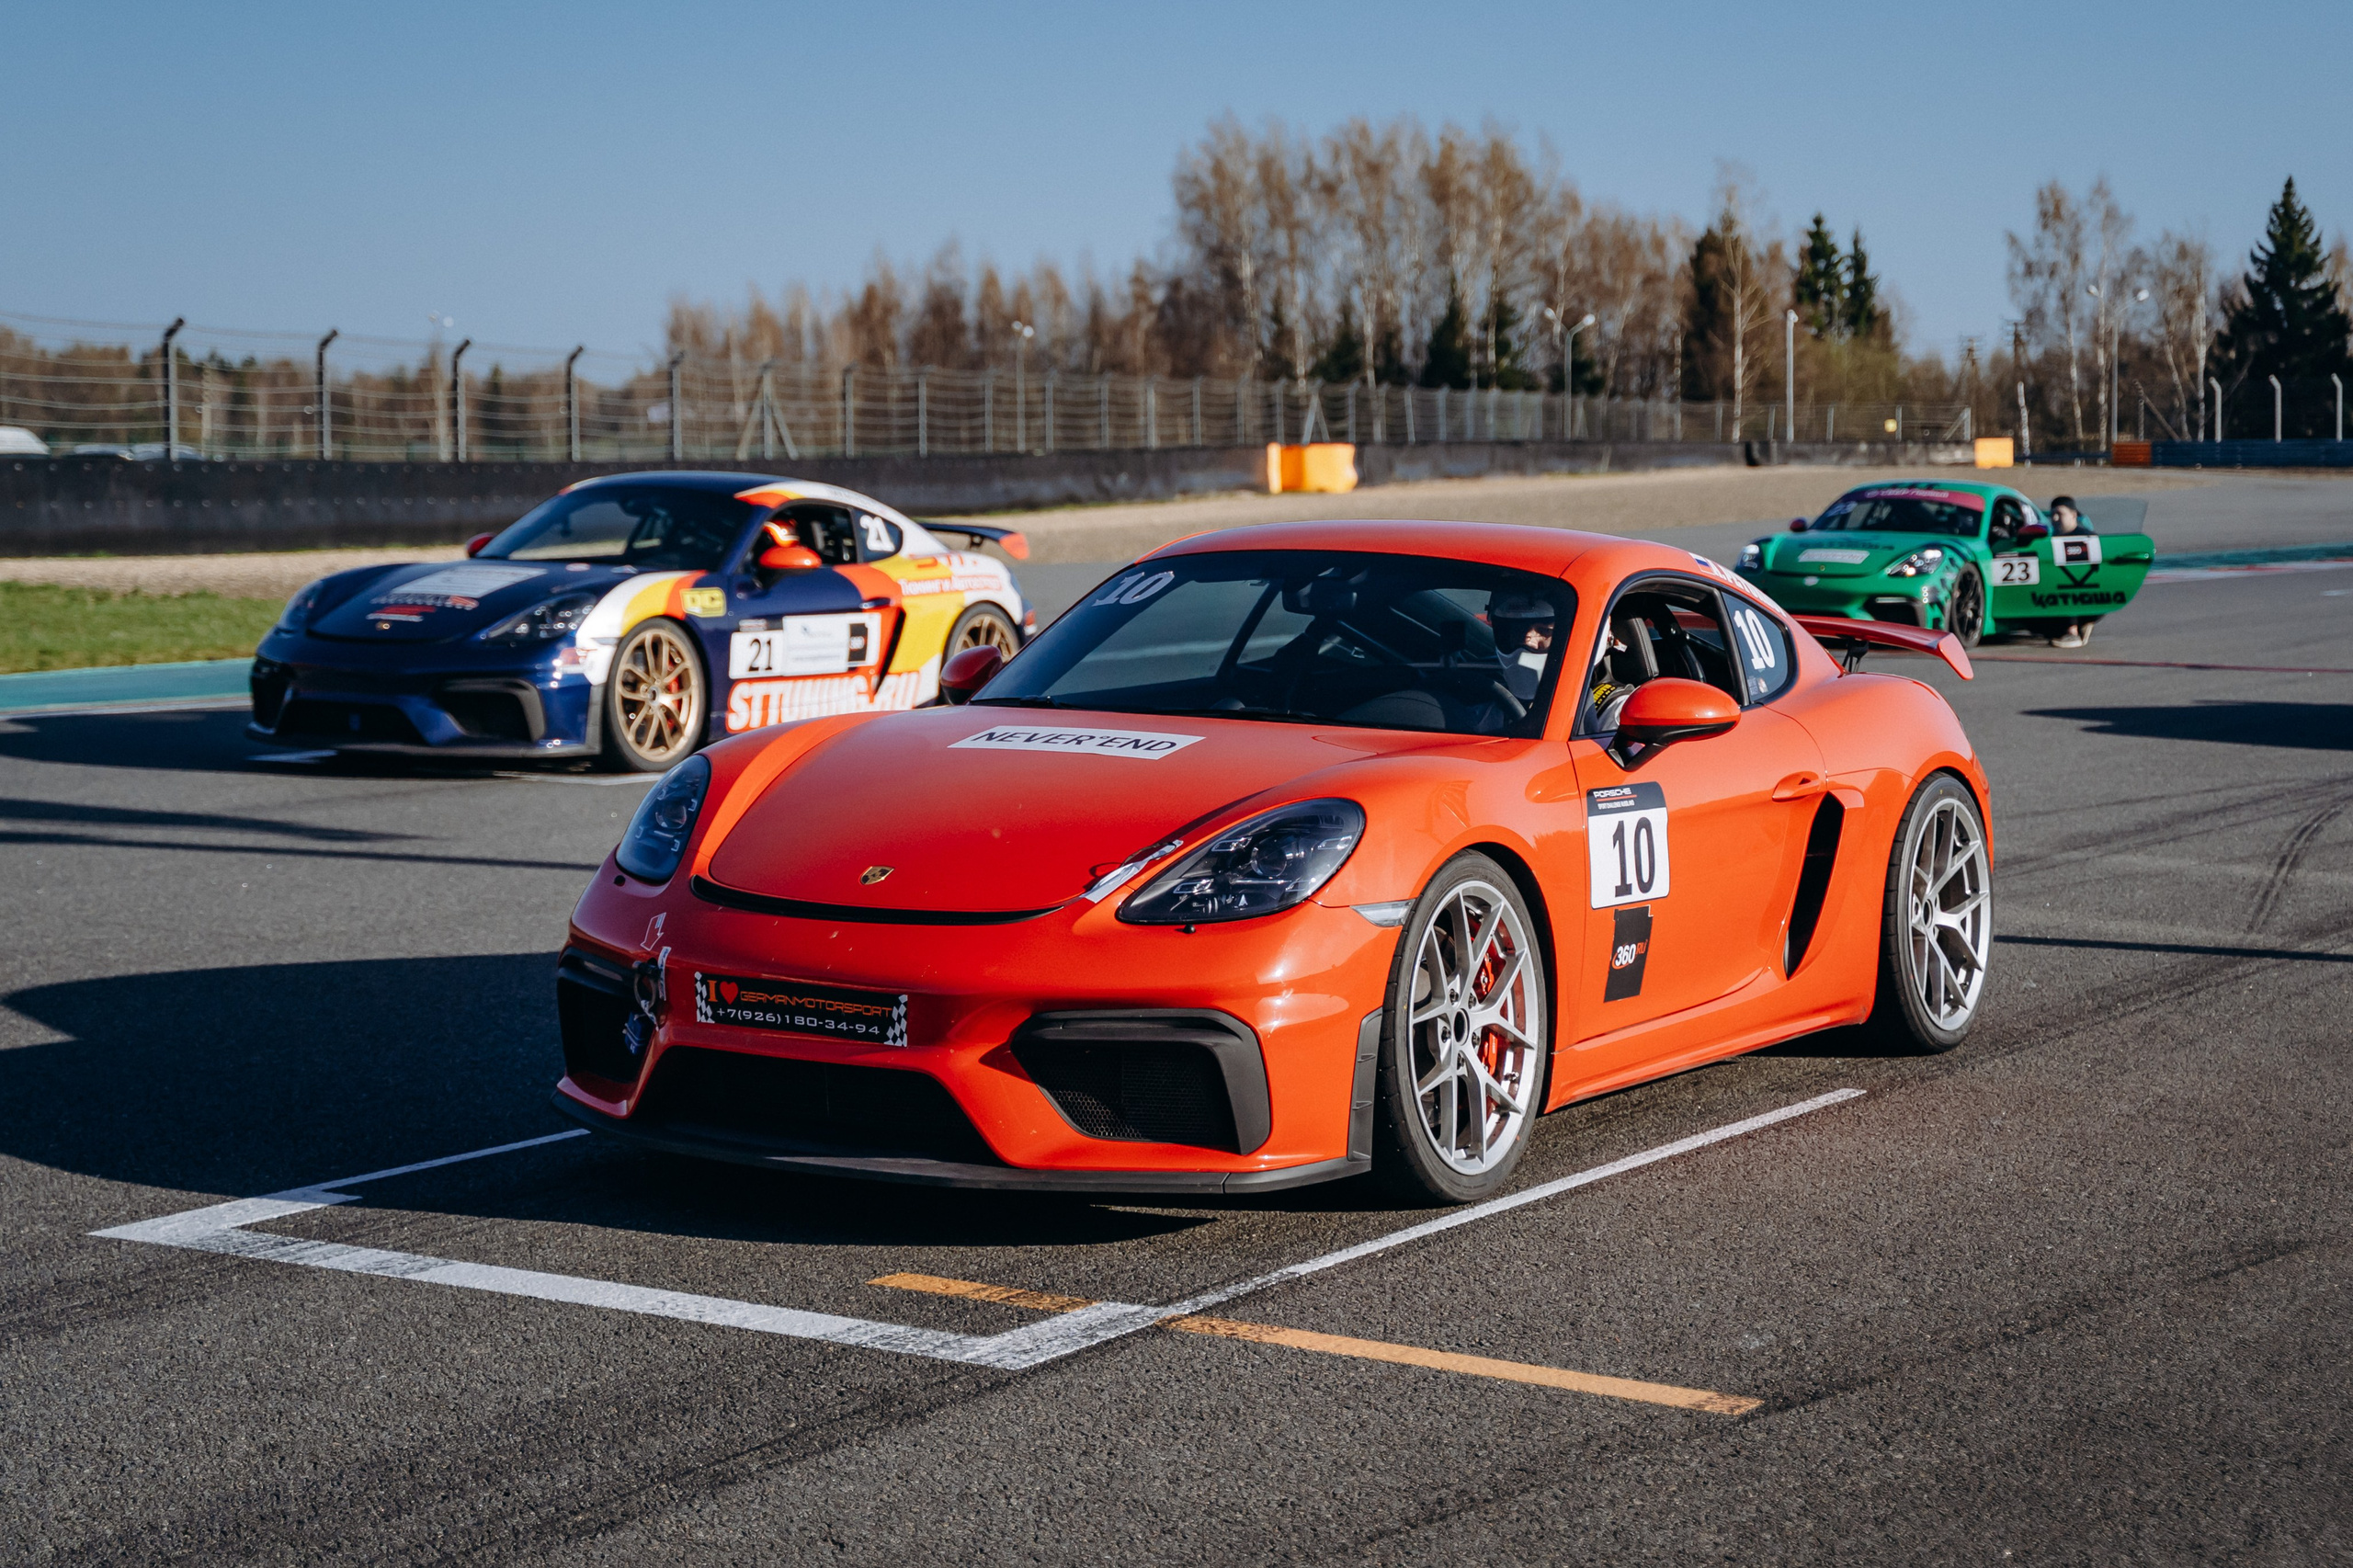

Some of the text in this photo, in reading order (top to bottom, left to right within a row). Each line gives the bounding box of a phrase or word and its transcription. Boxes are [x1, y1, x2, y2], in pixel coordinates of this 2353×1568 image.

[859, 515, 895, 551] 21
[1091, 571, 1175, 607] 10
[2001, 562, 2030, 582] 23
[748, 638, 773, 672] 21
[1733, 608, 1776, 670] 10
[1593, 788, 1632, 798] PORSCHE
[1612, 816, 1655, 898] 10
[707, 980, 892, 1017] I GERMANMOTORSPORT
[717, 1008, 881, 1035] +7(926)180-34-94
